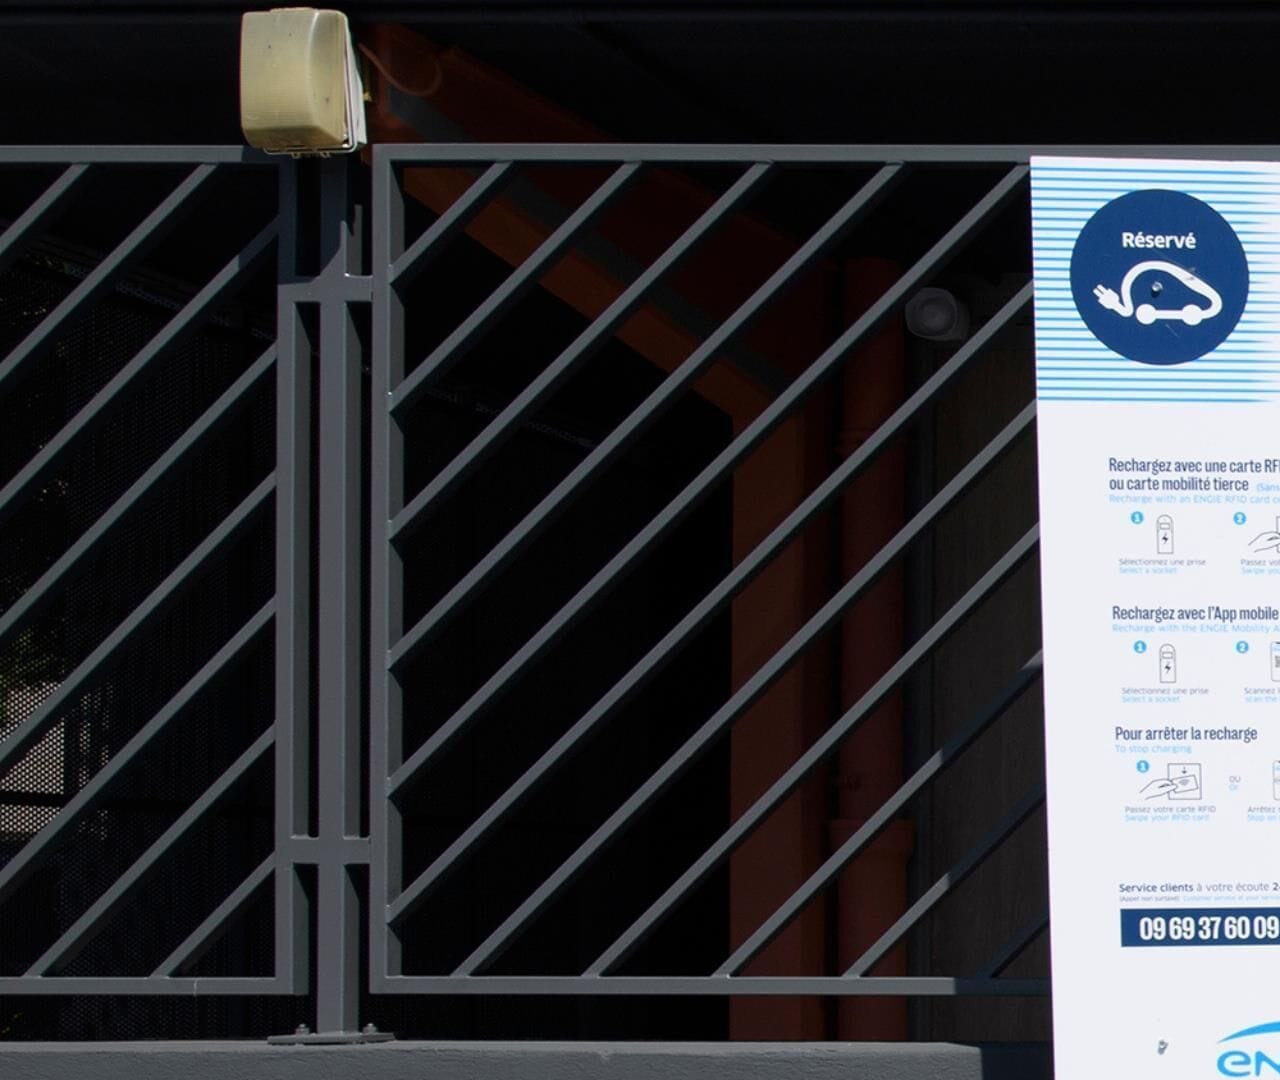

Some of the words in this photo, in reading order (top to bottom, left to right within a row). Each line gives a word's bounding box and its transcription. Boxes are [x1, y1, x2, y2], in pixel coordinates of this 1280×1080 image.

[1122, 231, 1196, 249] Réservé
[1109, 458, 1172, 474] Rechargez
[1175, 461, 1202, 472] avec
[1205, 462, 1227, 473] une
[1230, 460, 1262, 473] carte
[1110, 480, 1124, 490] ou
[1127, 478, 1159, 490] carte
[1162, 476, 1210, 490] mobilité
[1214, 478, 1248, 491] tierce
[1109, 495, 1152, 504] Recharge
[1156, 495, 1176, 503] with
[1194, 496, 1222, 504] ENGIE
[1225, 496, 1246, 504] RFID
[1250, 496, 1270, 504] card
[1113, 606, 1174, 622] Rechargez
[1178, 608, 1205, 620] avec
[1208, 606, 1236, 622] l'App
[1240, 606, 1278, 620] mobile
[1112, 624, 1154, 633] Recharge
[1158, 624, 1178, 632] with
[1182, 624, 1196, 632] the
[1200, 624, 1228, 632] ENGIE
[1232, 624, 1270, 634] Mobility
[1115, 727, 1142, 740] Pour
[1145, 727, 1187, 740] arrêter
[1191, 727, 1202, 740] la
[1204, 727, 1257, 743] recharge
[1129, 745, 1148, 753] stop
[1152, 745, 1192, 754] charging
[1119, 884, 1157, 892] Service
[1160, 883, 1193, 892] clients
[1196, 883, 1203, 891] à
[1236, 883, 1269, 891] écoute
[1140, 917, 1166, 940] 09
[1169, 917, 1195, 939] 69
[1199, 917, 1222, 939] 37
[1225, 917, 1249, 939] 60
[1254, 916, 1279, 938] 09
